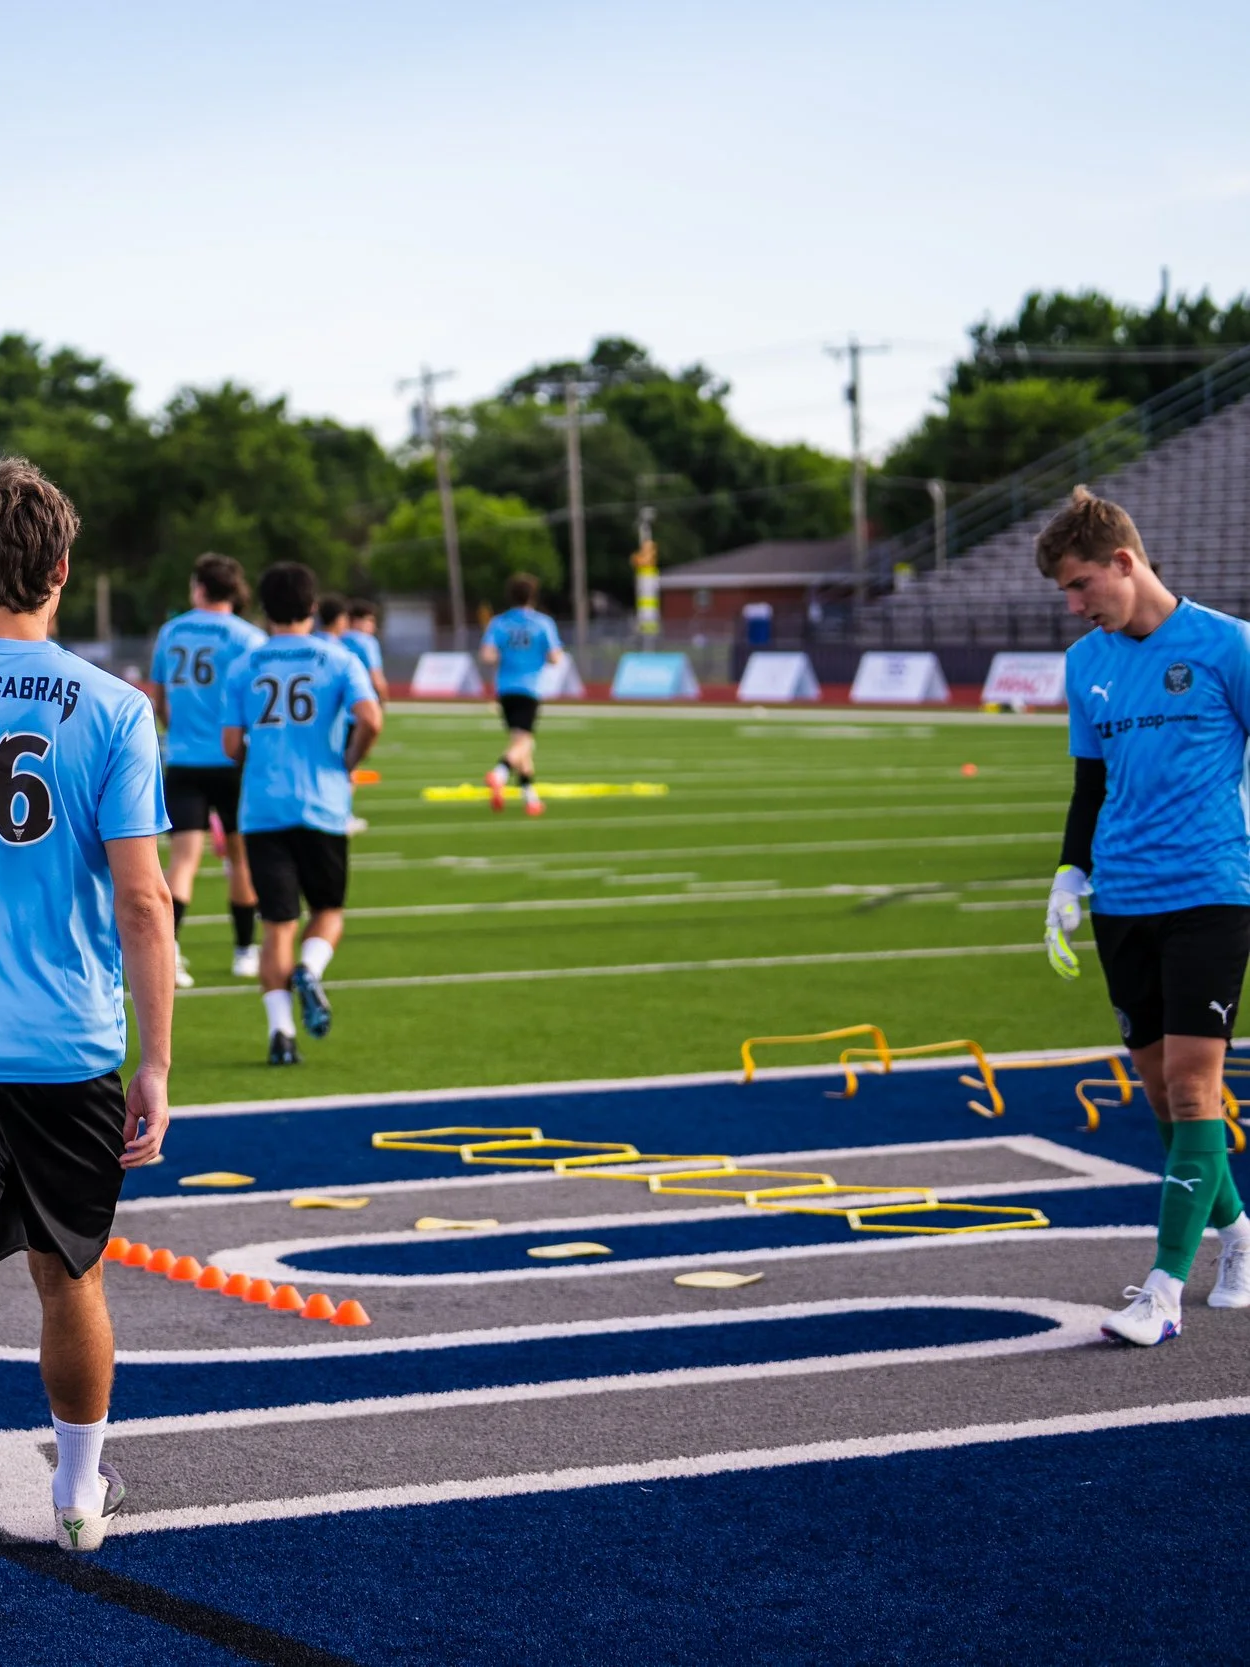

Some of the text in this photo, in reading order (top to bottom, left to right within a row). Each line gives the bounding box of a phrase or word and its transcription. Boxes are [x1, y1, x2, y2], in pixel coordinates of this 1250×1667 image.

[168, 645, 214, 686] 26
[252, 673, 316, 729] 26
[1115, 717, 1133, 733] zp
[1136, 713, 1165, 730] zap
